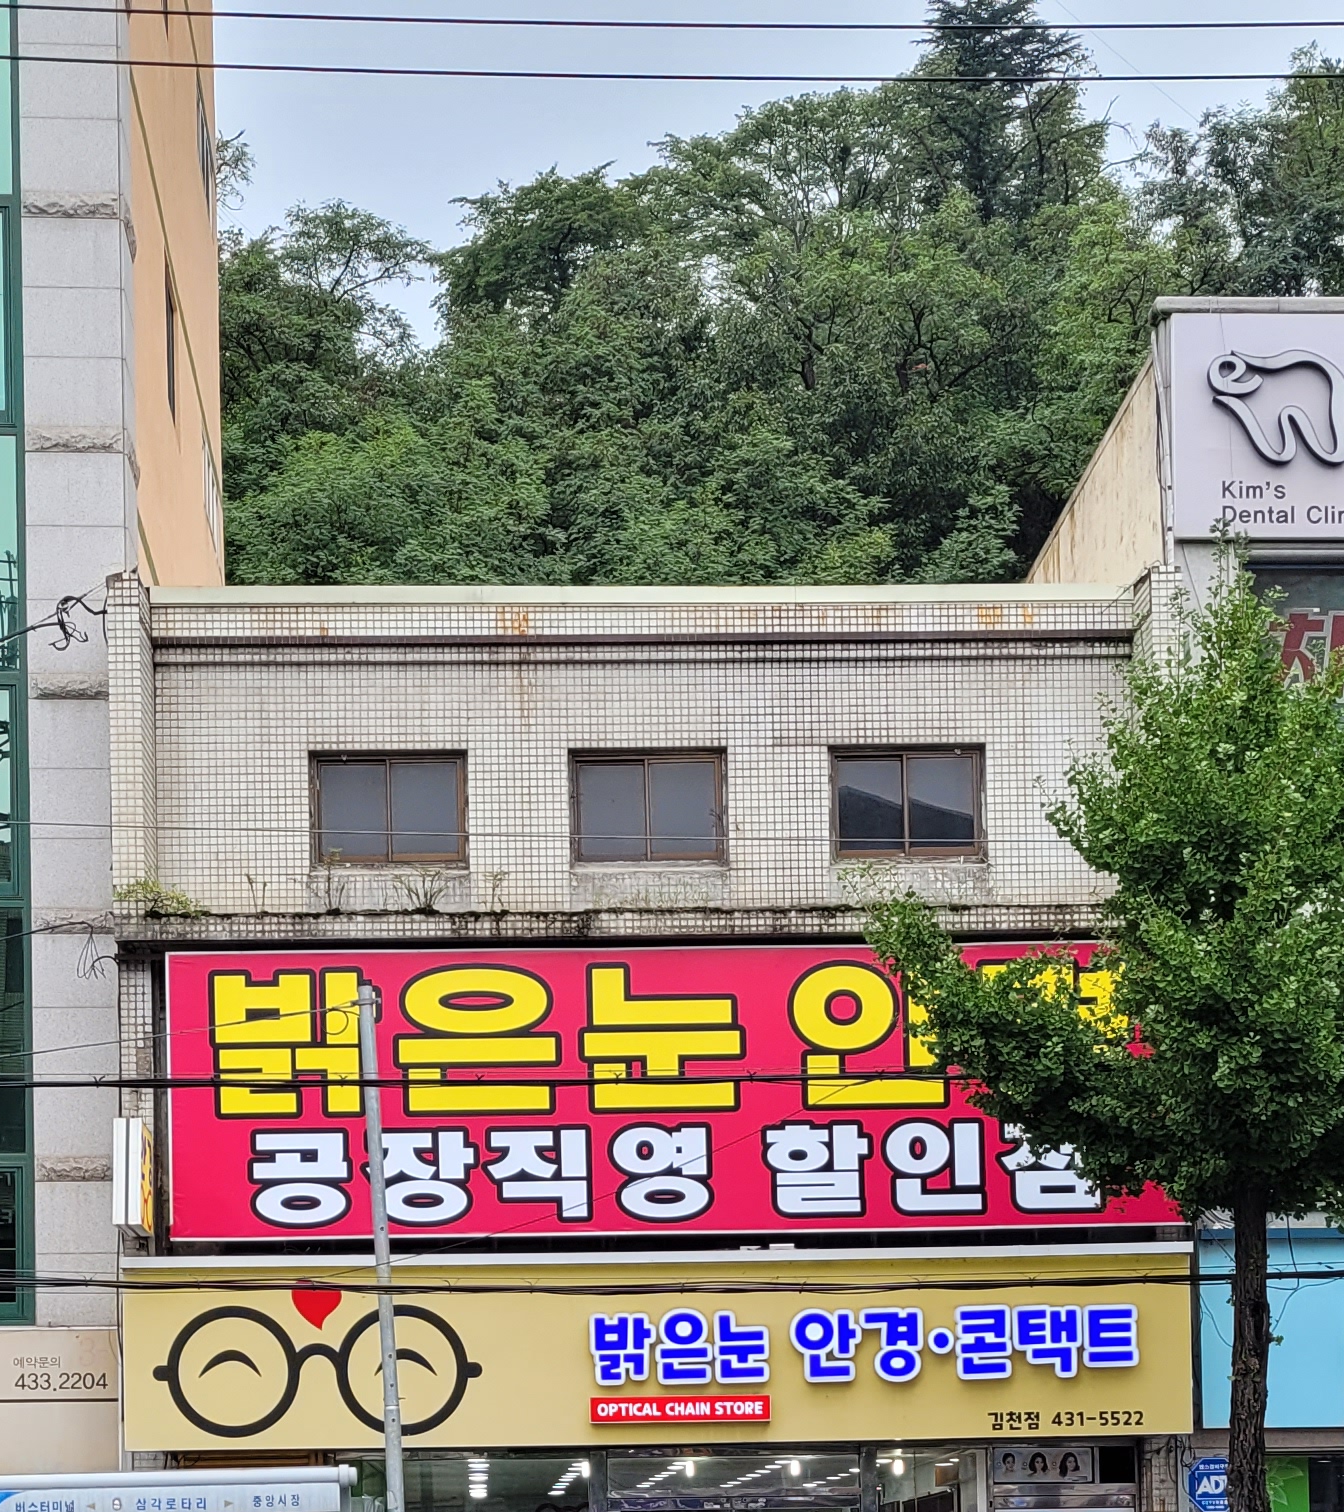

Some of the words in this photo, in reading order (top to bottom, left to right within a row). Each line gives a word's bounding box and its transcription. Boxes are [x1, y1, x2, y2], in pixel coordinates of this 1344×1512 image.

[1221, 505, 1296, 525] Dental
[208, 962, 747, 1118] 밝은눈
[251, 1118, 716, 1228] 공장직영
[588, 1308, 770, 1387] 밝은눈
[13, 1355, 62, 1370] 예약문의
[14, 1373, 109, 1393] 433.2204
[596, 1402, 661, 1418] OPTICAL
[665, 1401, 711, 1417] CHAIN
[715, 1400, 764, 1417] STORE
[986, 1410, 1041, 1431] 김천점
[1051, 1409, 1144, 1428] 431-5522
[135, 1497, 207, 1512] 삼각로타리
[252, 1493, 301, 1508] 중앙시장
